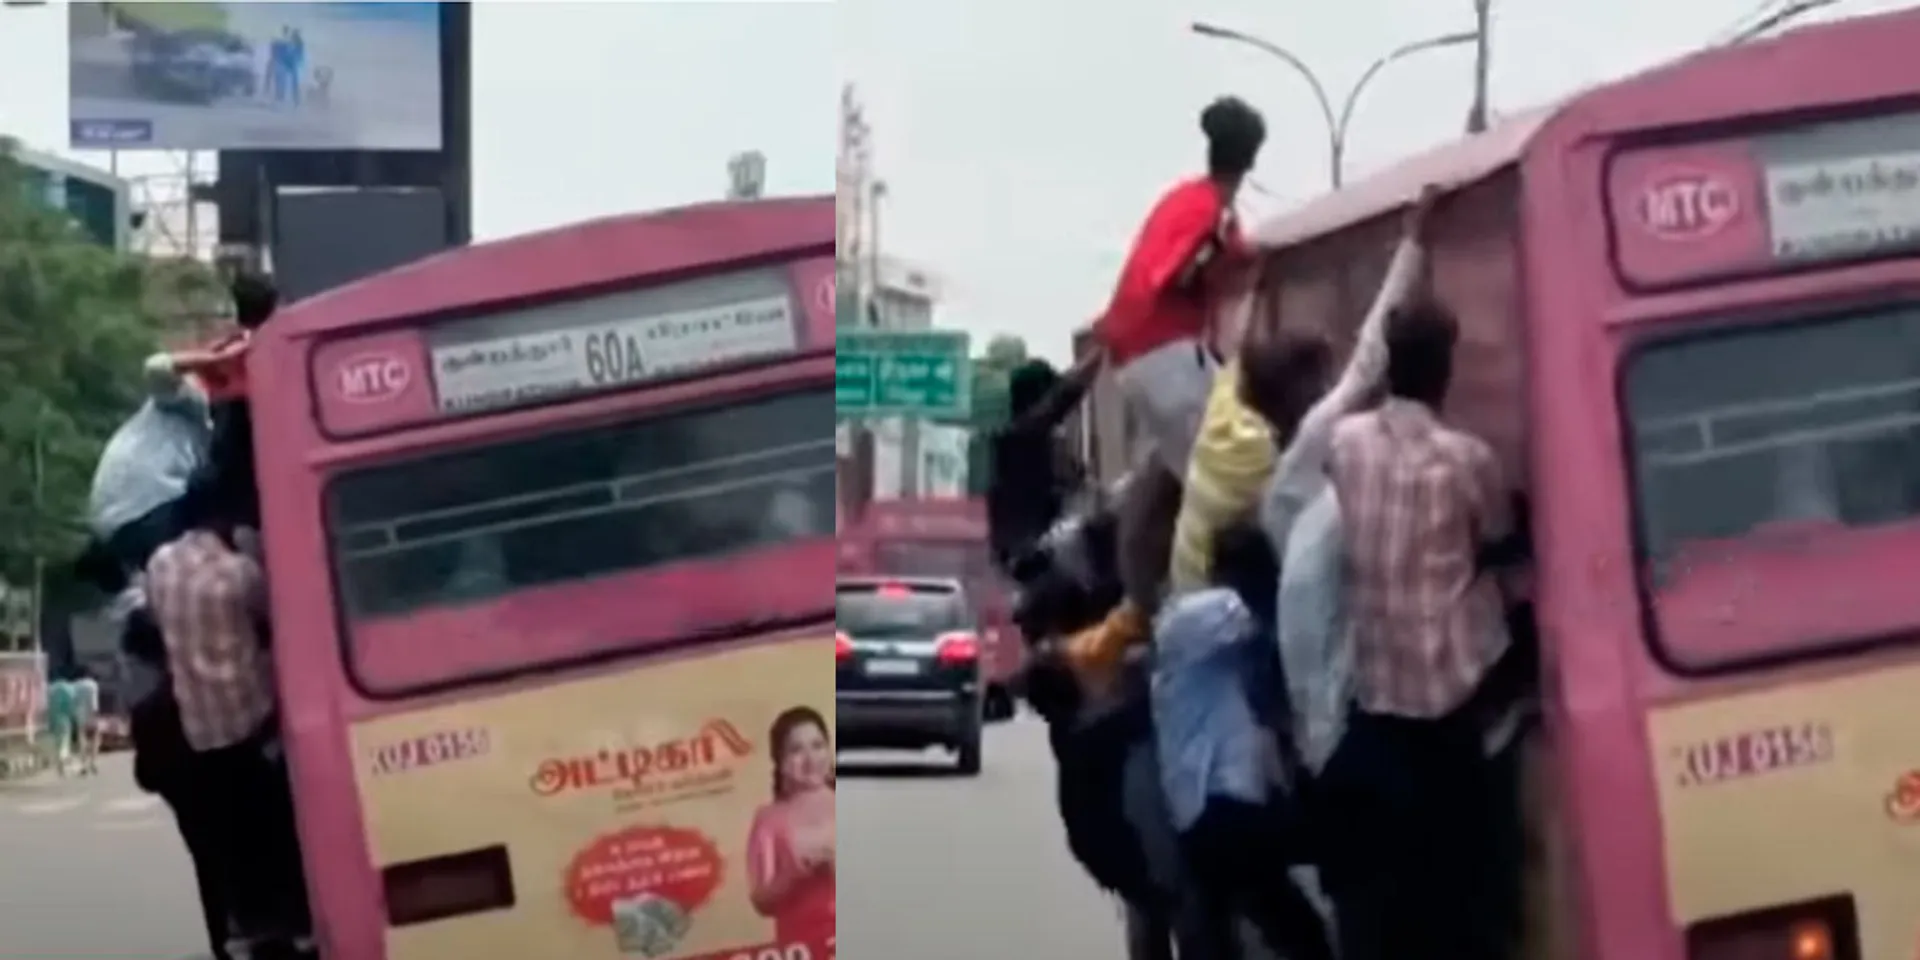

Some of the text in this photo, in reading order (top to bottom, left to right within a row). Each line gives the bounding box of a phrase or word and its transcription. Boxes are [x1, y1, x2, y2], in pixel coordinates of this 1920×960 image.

[1642, 179, 1732, 229] MTC
[341, 359, 408, 395] MTC
[585, 329, 646, 385] 60A
